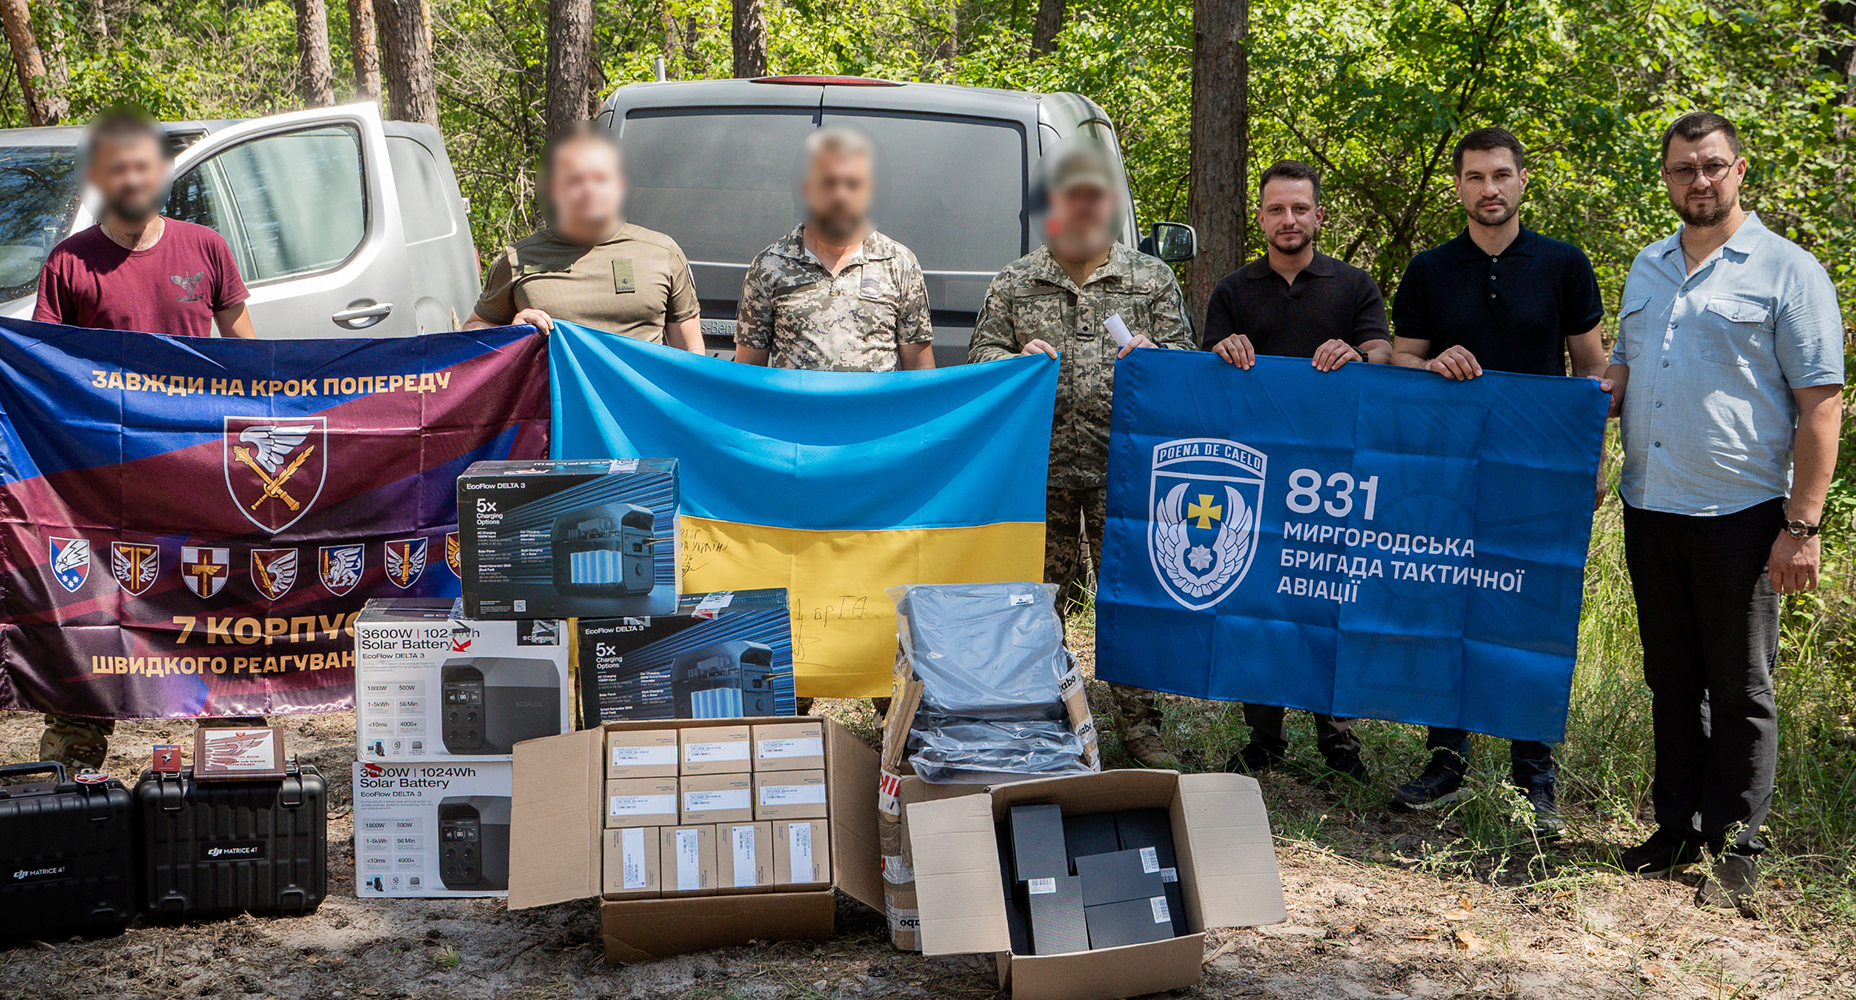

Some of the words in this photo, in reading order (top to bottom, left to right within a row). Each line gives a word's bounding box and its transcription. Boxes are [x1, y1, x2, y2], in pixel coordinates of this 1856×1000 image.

[92, 370, 204, 396] ЗАВЖДИ
[210, 378, 245, 396] НА
[251, 378, 317, 396] КРОК
[323, 372, 451, 395] ПОПЕРЕДУ
[1160, 444, 1199, 462] POENA
[1204, 444, 1220, 456] DE
[1224, 446, 1261, 470] CAELO
[1286, 469, 1379, 521] 831
[476, 498, 497, 513] 5x
[1284, 522, 1475, 558] МИРГОРОДСЬКА
[1280, 548, 1384, 578] БРИГАДА
[1390, 561, 1525, 594] ТАКТИЧНОЇ
[1276, 576, 1362, 604] АВІАЦІЇ
[172, 616, 197, 644] 7
[362, 629, 412, 639] 3600W
[361, 640, 398, 649] Solar
[402, 640, 453, 651] Battery
[596, 642, 616, 656] 5x
[92, 656, 227, 678] ШВИДКОГО
[234, 650, 355, 673] РЕАГУВАН
[596, 655, 622, 664] Charging
[421, 768, 476, 778] 1024Wh
[360, 778, 395, 788] Solar
[400, 779, 449, 790] Battery
[30, 868, 57, 876] MATRICE
